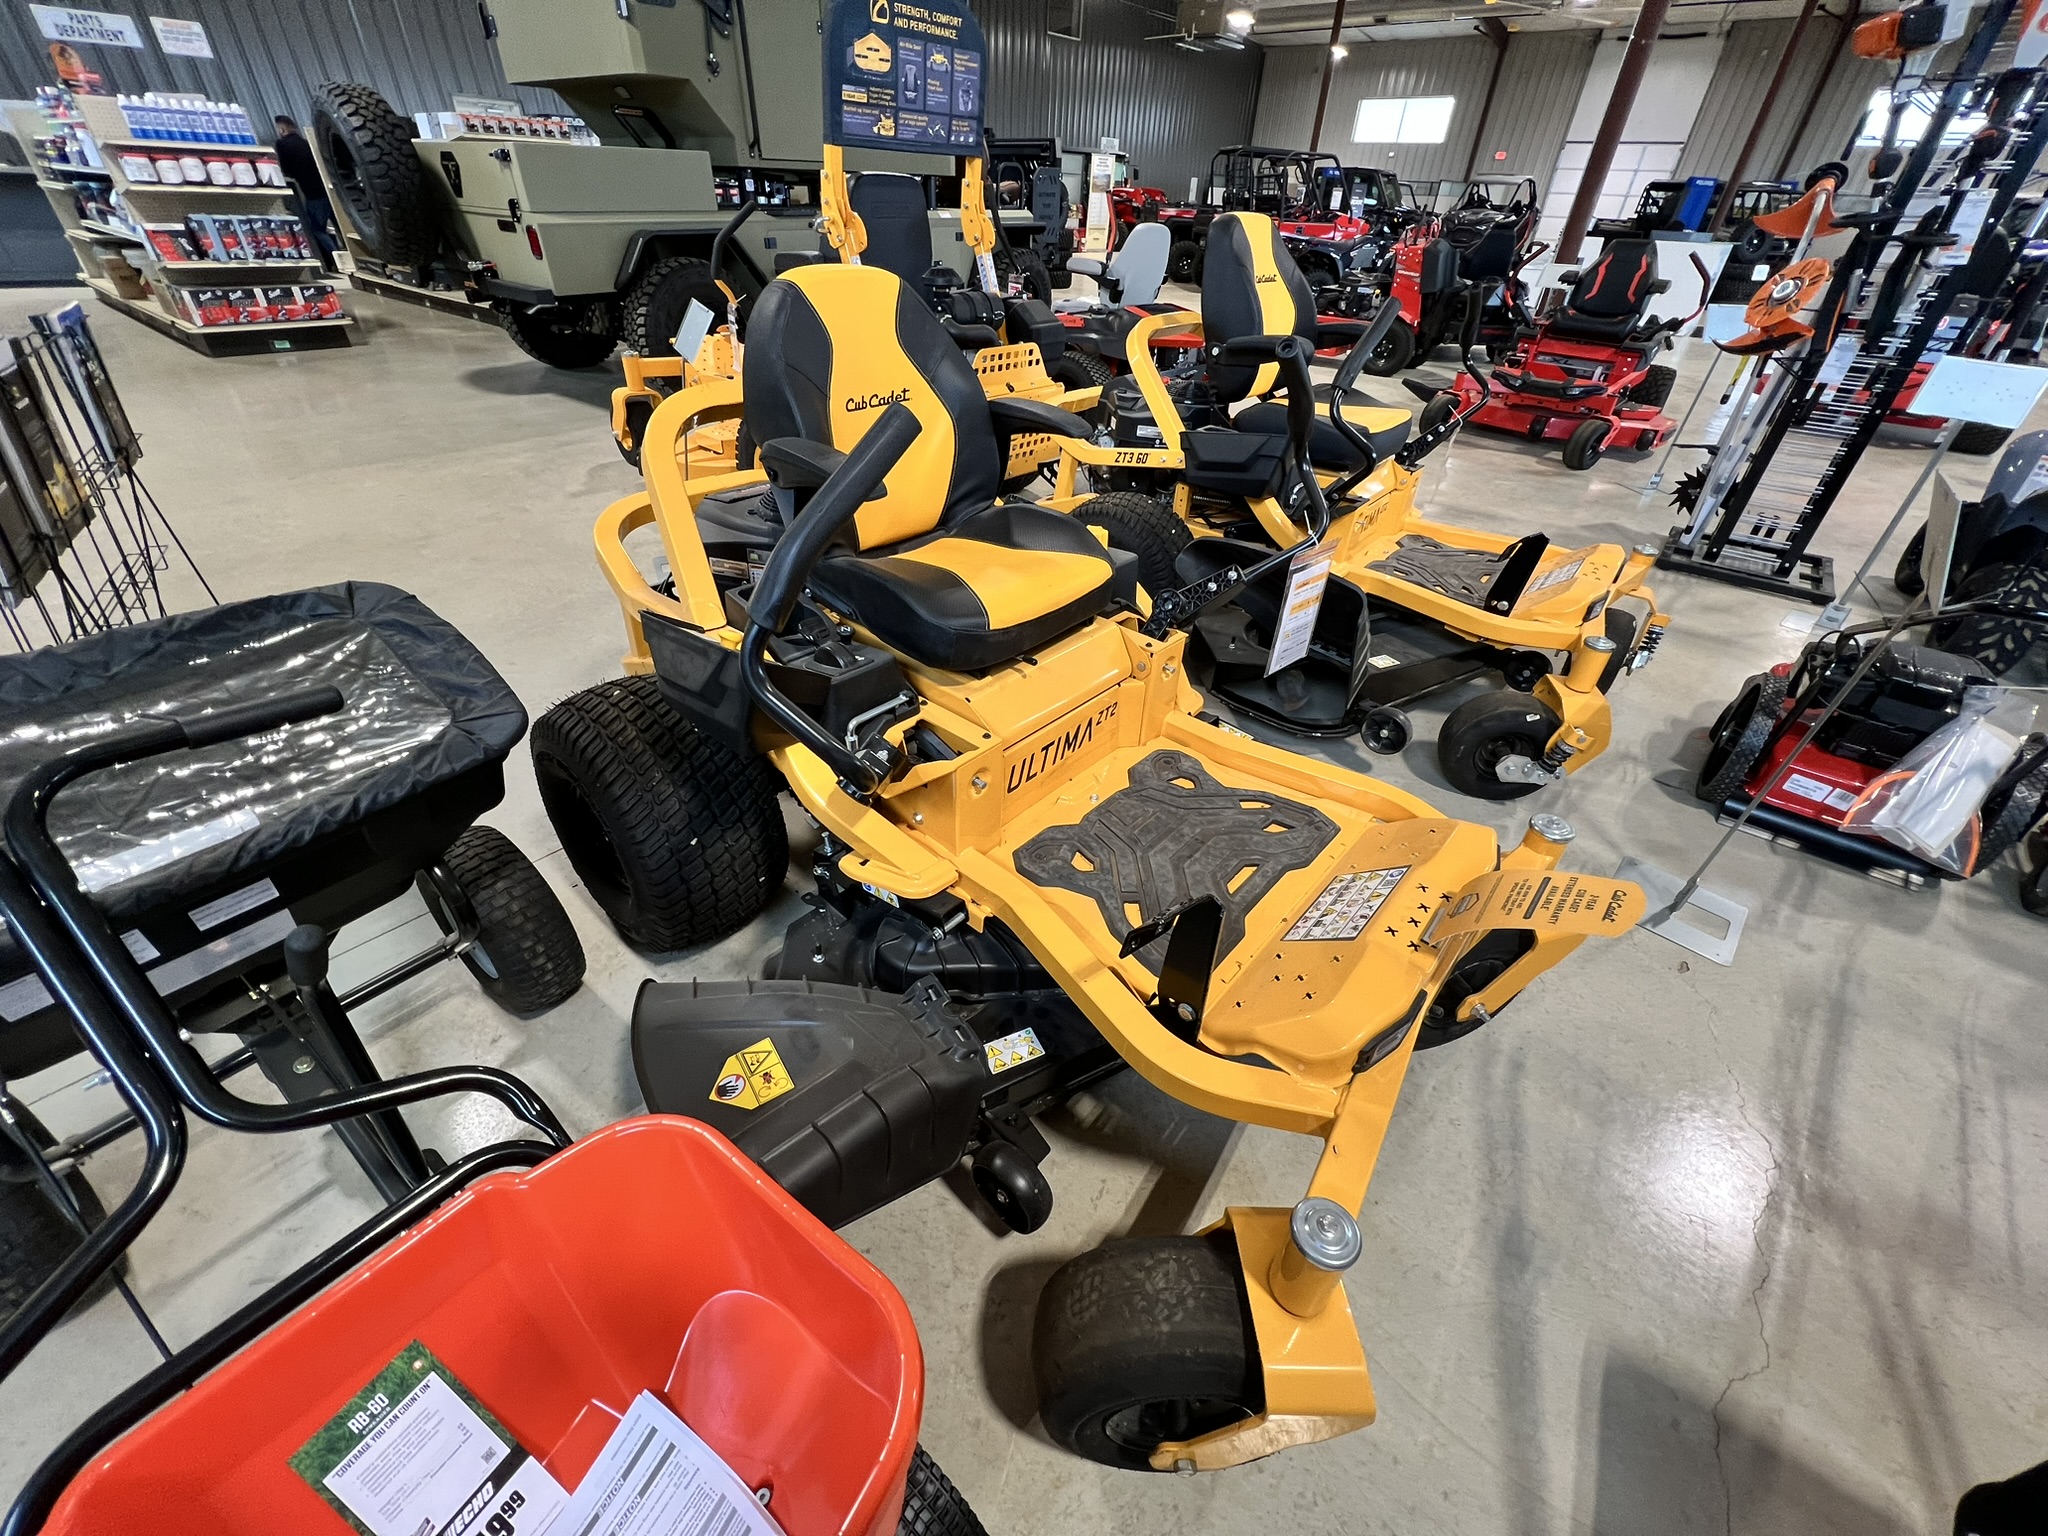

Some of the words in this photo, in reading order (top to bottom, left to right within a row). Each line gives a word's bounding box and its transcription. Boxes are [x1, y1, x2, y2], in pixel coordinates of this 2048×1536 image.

[67, 12, 103, 27] PARTS
[893, 16, 909, 29] AND
[894, 2, 931, 21] STRENGTH,
[932, 12, 963, 27] COMFORT
[54, 23, 129, 43] DEPARTMENT
[845, 395, 868, 413] Cub
[869, 387, 911, 409] Cadet
[1114, 452, 1135, 464] ZT3
[1007, 716, 1094, 794] ULTIMA
[1096, 701, 1118, 727] ZT2
[1562, 876, 1579, 900] EXTENDED
[1575, 888, 1588, 901] CUB
[1610, 889, 1628, 903] Cub
[1548, 898, 1568, 925] WARRANTY
[1568, 899, 1582, 914] CADET
[1602, 901, 1623, 923] Cadet
[347, 1392, 389, 1434] RB-60
[370, 1427, 387, 1444] YOU
[384, 1413, 401, 1430] CAN
[397, 1393, 421, 1416] COUNT
[453, 1480, 494, 1536] ECHO
[597, 1476, 626, 1520] NOTICE
